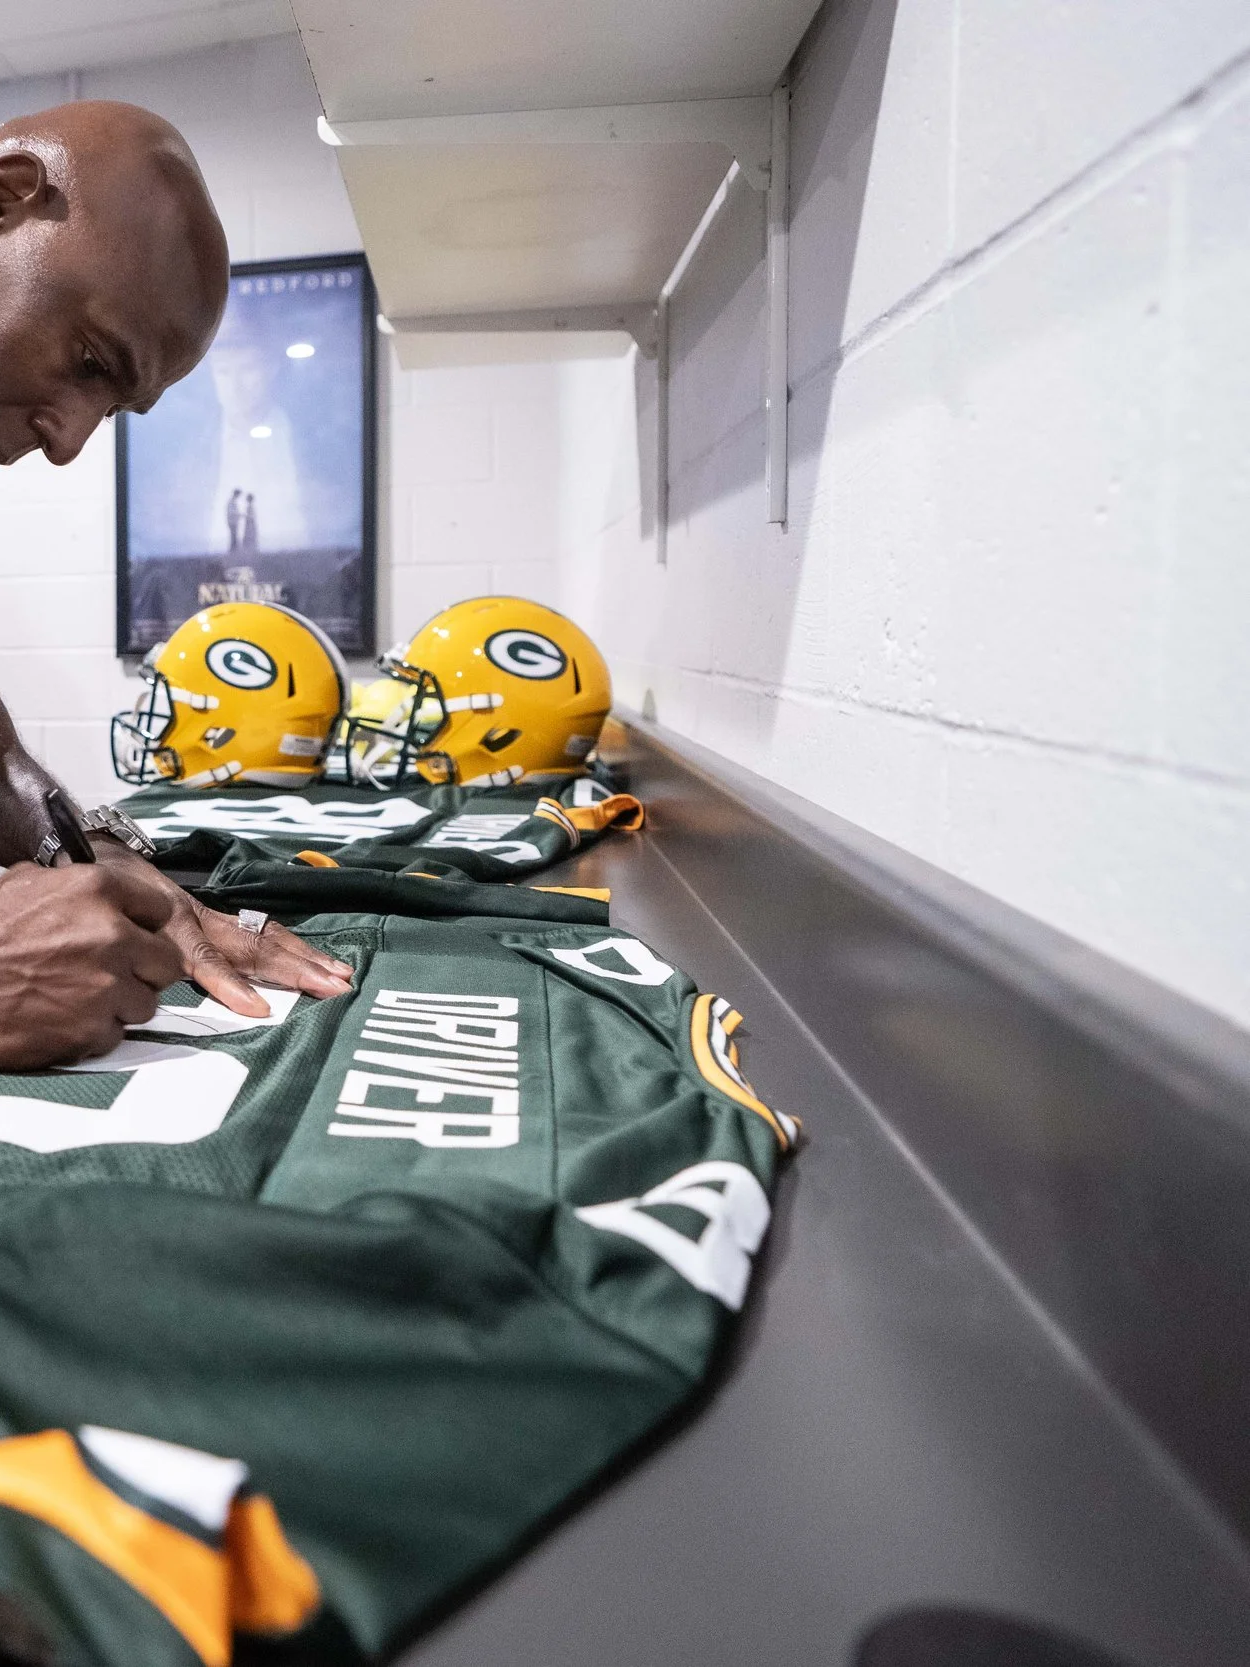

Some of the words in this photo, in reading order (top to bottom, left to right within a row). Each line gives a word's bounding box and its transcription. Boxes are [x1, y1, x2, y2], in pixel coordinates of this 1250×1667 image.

[206, 639, 277, 690] G
[486, 631, 565, 679] G
[327, 989, 520, 1149] DRIVER
